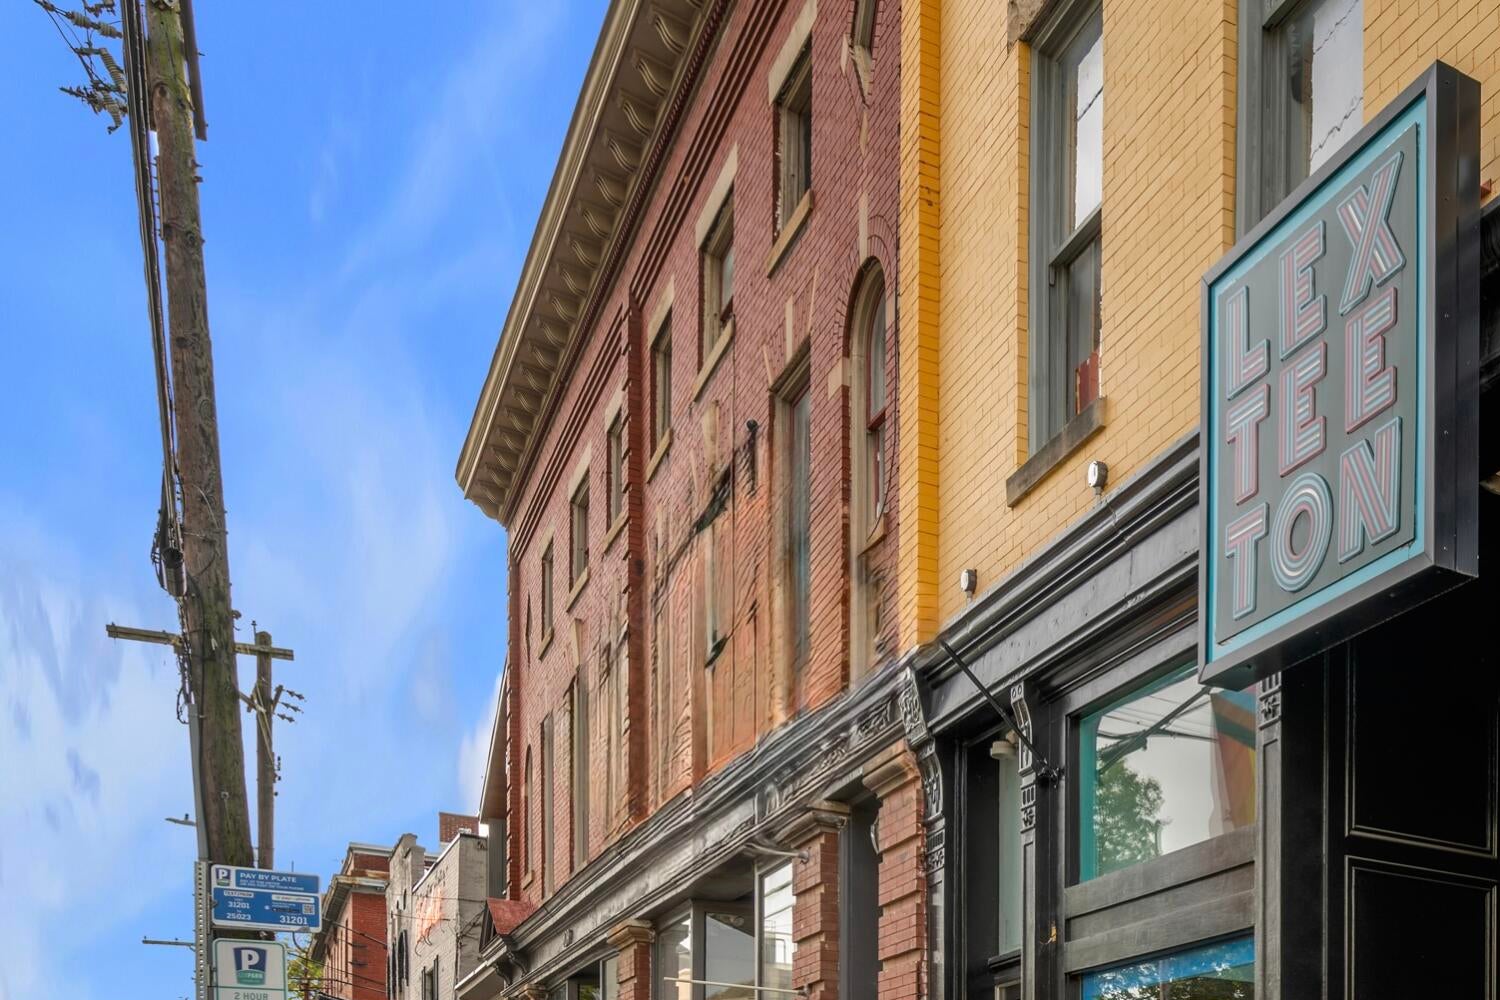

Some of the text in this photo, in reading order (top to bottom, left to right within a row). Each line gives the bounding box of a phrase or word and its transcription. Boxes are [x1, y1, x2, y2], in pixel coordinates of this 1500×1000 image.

[271, 875, 297, 883] PLATE
[279, 915, 308, 925] 31201
[234, 991, 269, 1000] 2 HOUR
